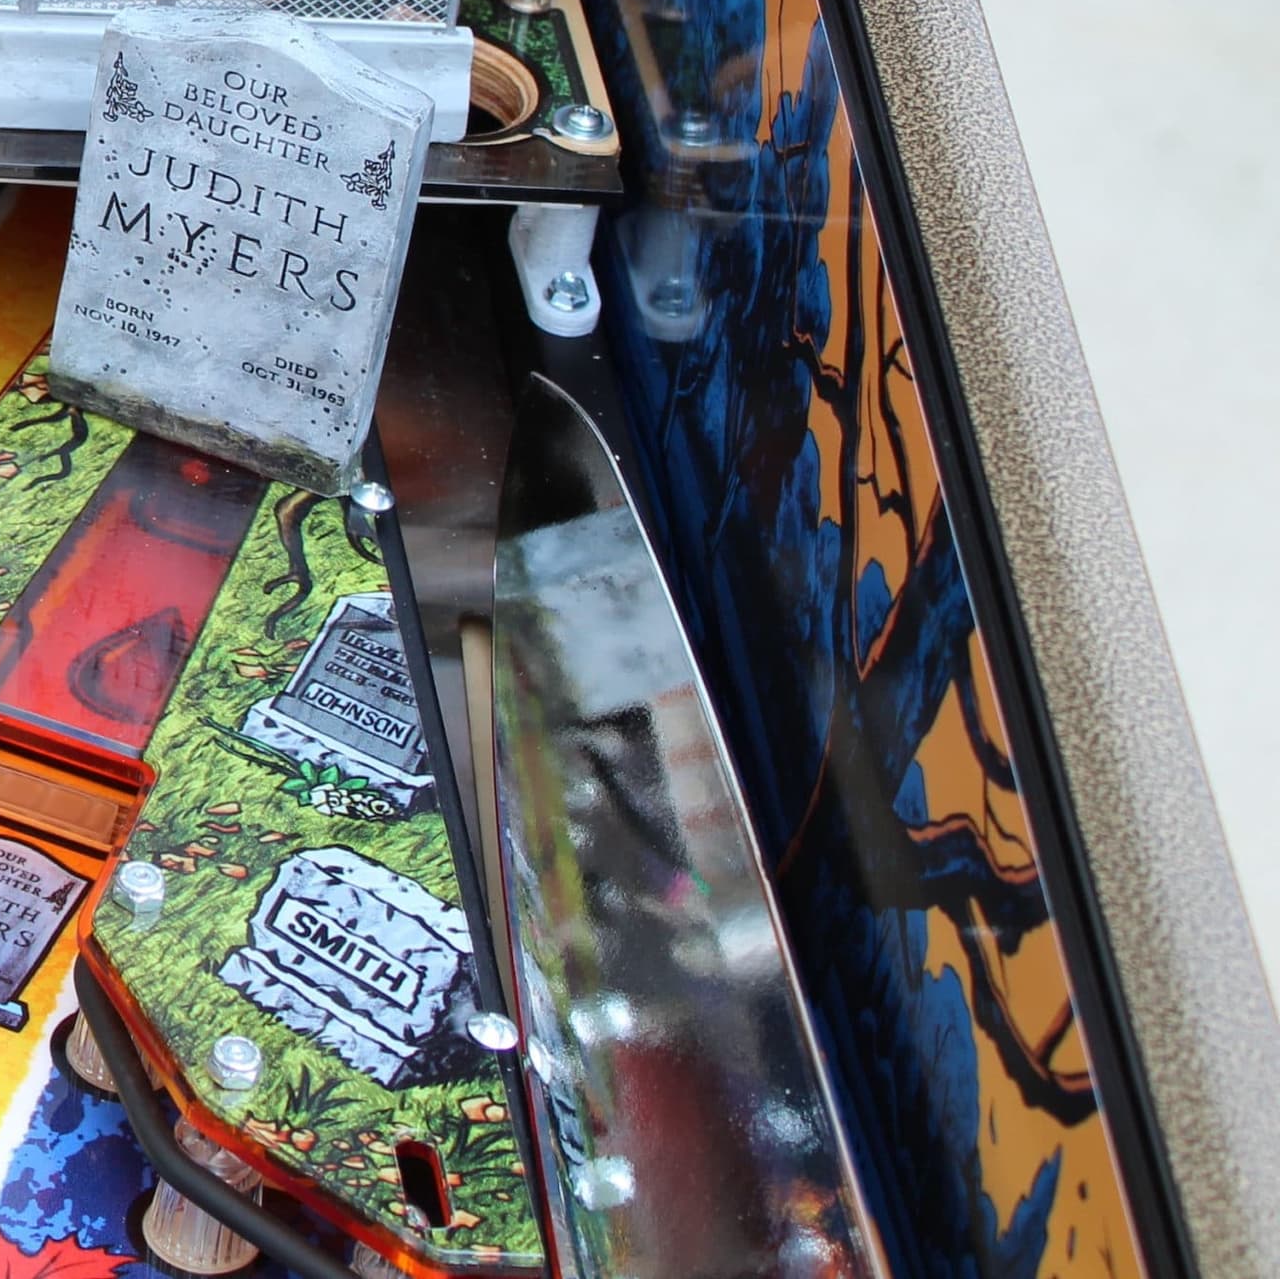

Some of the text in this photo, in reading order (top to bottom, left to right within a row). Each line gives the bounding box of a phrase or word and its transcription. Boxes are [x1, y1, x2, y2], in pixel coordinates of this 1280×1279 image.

[183, 83, 324, 142] BELOVED
[223, 70, 289, 108] OUR
[161, 102, 331, 174] DAUGHTER
[127, 147, 350, 245] JUDITH
[98, 191, 360, 312] MYERS
[73, 304, 117, 329] NOV.
[145, 328, 182, 349] 1947
[105, 297, 155, 323] BORN
[240, 361, 283, 386] OCT.
[311, 385, 346, 408] 1963
[274, 355, 319, 381] DIED
[305, 684, 407, 740] JOHNSON
[289, 908, 409, 993] SMITH
